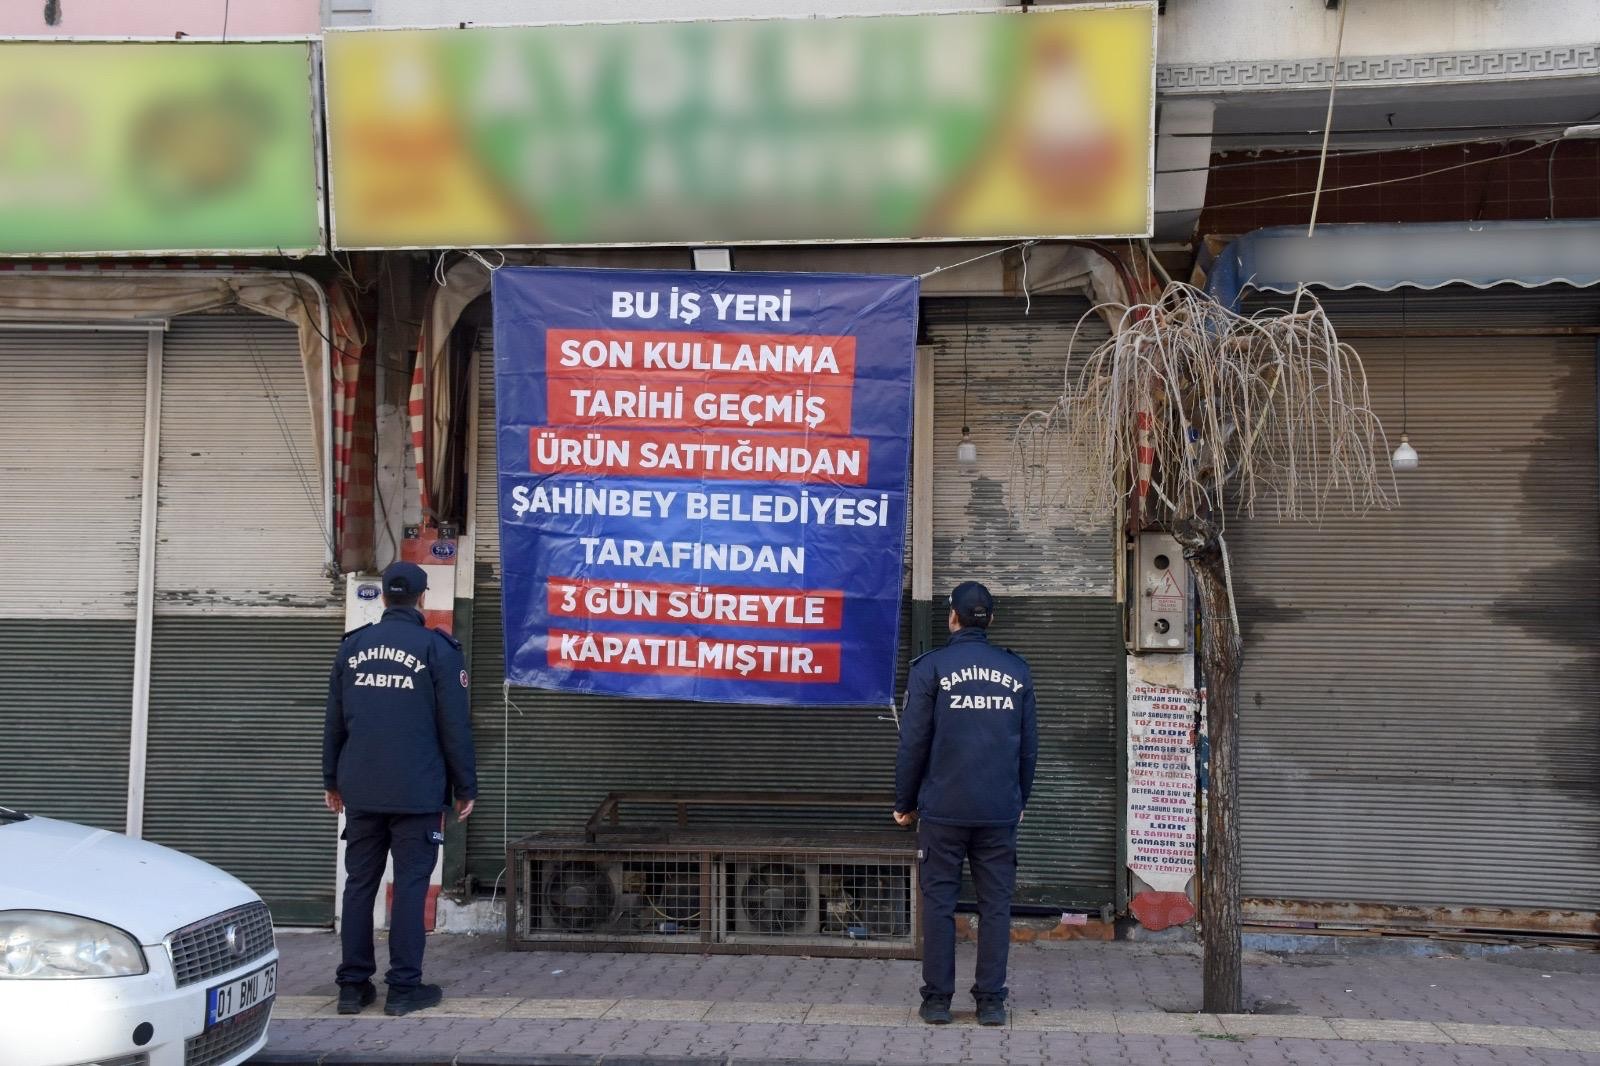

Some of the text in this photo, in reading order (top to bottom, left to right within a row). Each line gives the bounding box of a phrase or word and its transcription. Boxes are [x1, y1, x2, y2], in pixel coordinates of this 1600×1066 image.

[612, 286, 792, 324] BU İŞ YERİ
[560, 340, 840, 374] SON KULLANMA
[570, 385, 826, 430] TARİHİ GEÇMİŞ
[537, 433, 860, 476] ÜRÜN SATTIĞINDAN
[511, 482, 889, 527] ŞAHİNBEY BELEDİYESİ
[579, 537, 805, 575] TARAFINDAN
[560, 583, 825, 624] 3 GÜN SÜREYLE
[348, 644, 426, 674] ŞAHİNBEY
[560, 634, 823, 677] KAPATILMIŞTIR.
[355, 672, 415, 690] ZABITA
[940, 665, 1023, 692] ŞAHİNBEY
[950, 695, 1014, 709] ZABITA
[1152, 703, 1187, 711] SODA
[1135, 719, 1152, 727] TOZ
[1150, 728, 1187, 737] LOOK
[1145, 737, 1183, 745] SABUNU
[1132, 744, 1176, 754] ÇAMAŞIR
[1135, 761, 1160, 770] KREÇ
[1131, 787, 1165, 796] DETERJAN
[1167, 789, 1181, 797] SIVI
[1151, 796, 1187, 805] SODA
[1147, 804, 1171, 813] SABUNU
[1134, 812, 1152, 820] TOZ
[1150, 822, 1187, 831] LOOK
[1130, 829, 1141, 837] EL
[1144, 830, 1183, 839] SABUNU
[1131, 837, 1176, 848] ÇAMAŞIR
[1133, 854, 1159, 864] KREÇ
[1128, 862, 1153, 871] YÜZEY
[218, 987, 231, 1017] 01
[240, 976, 258, 1008] BMU
